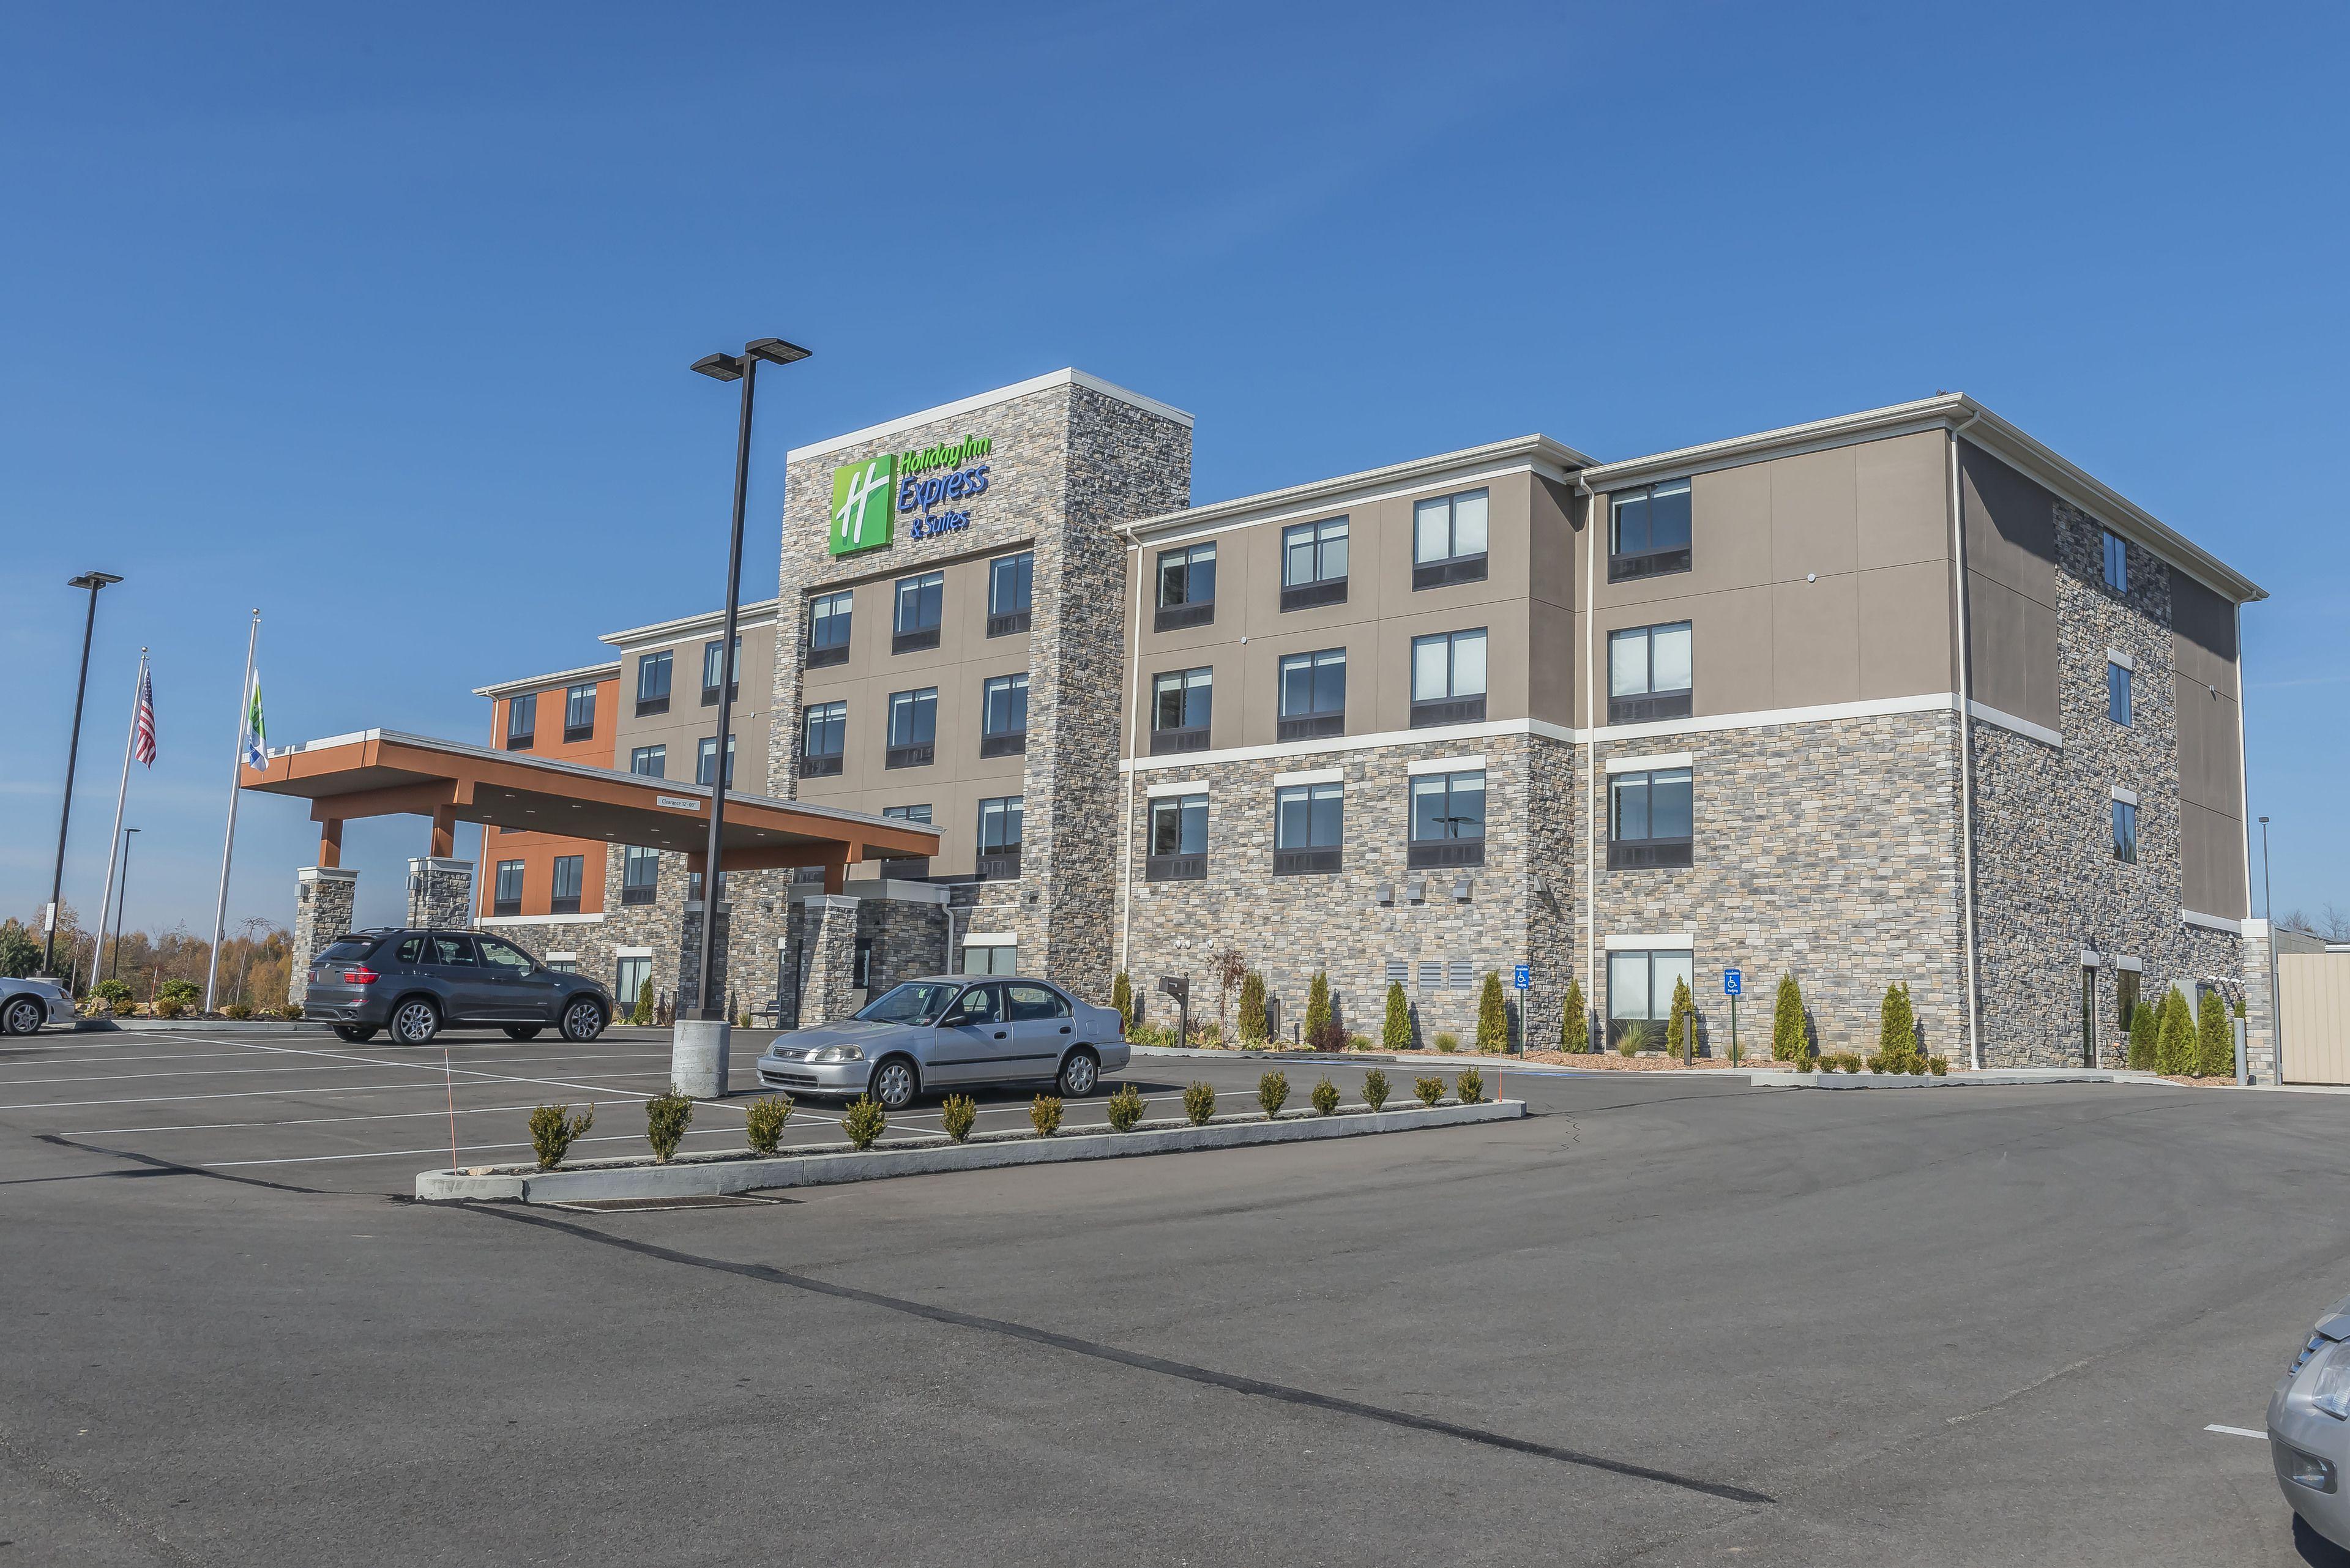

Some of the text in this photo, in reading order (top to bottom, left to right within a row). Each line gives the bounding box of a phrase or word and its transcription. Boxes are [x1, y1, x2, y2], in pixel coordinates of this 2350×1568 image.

[900, 434, 991, 475] Holiday Inn
[897, 465, 990, 513] Express
[911, 510, 971, 539] & Suites
